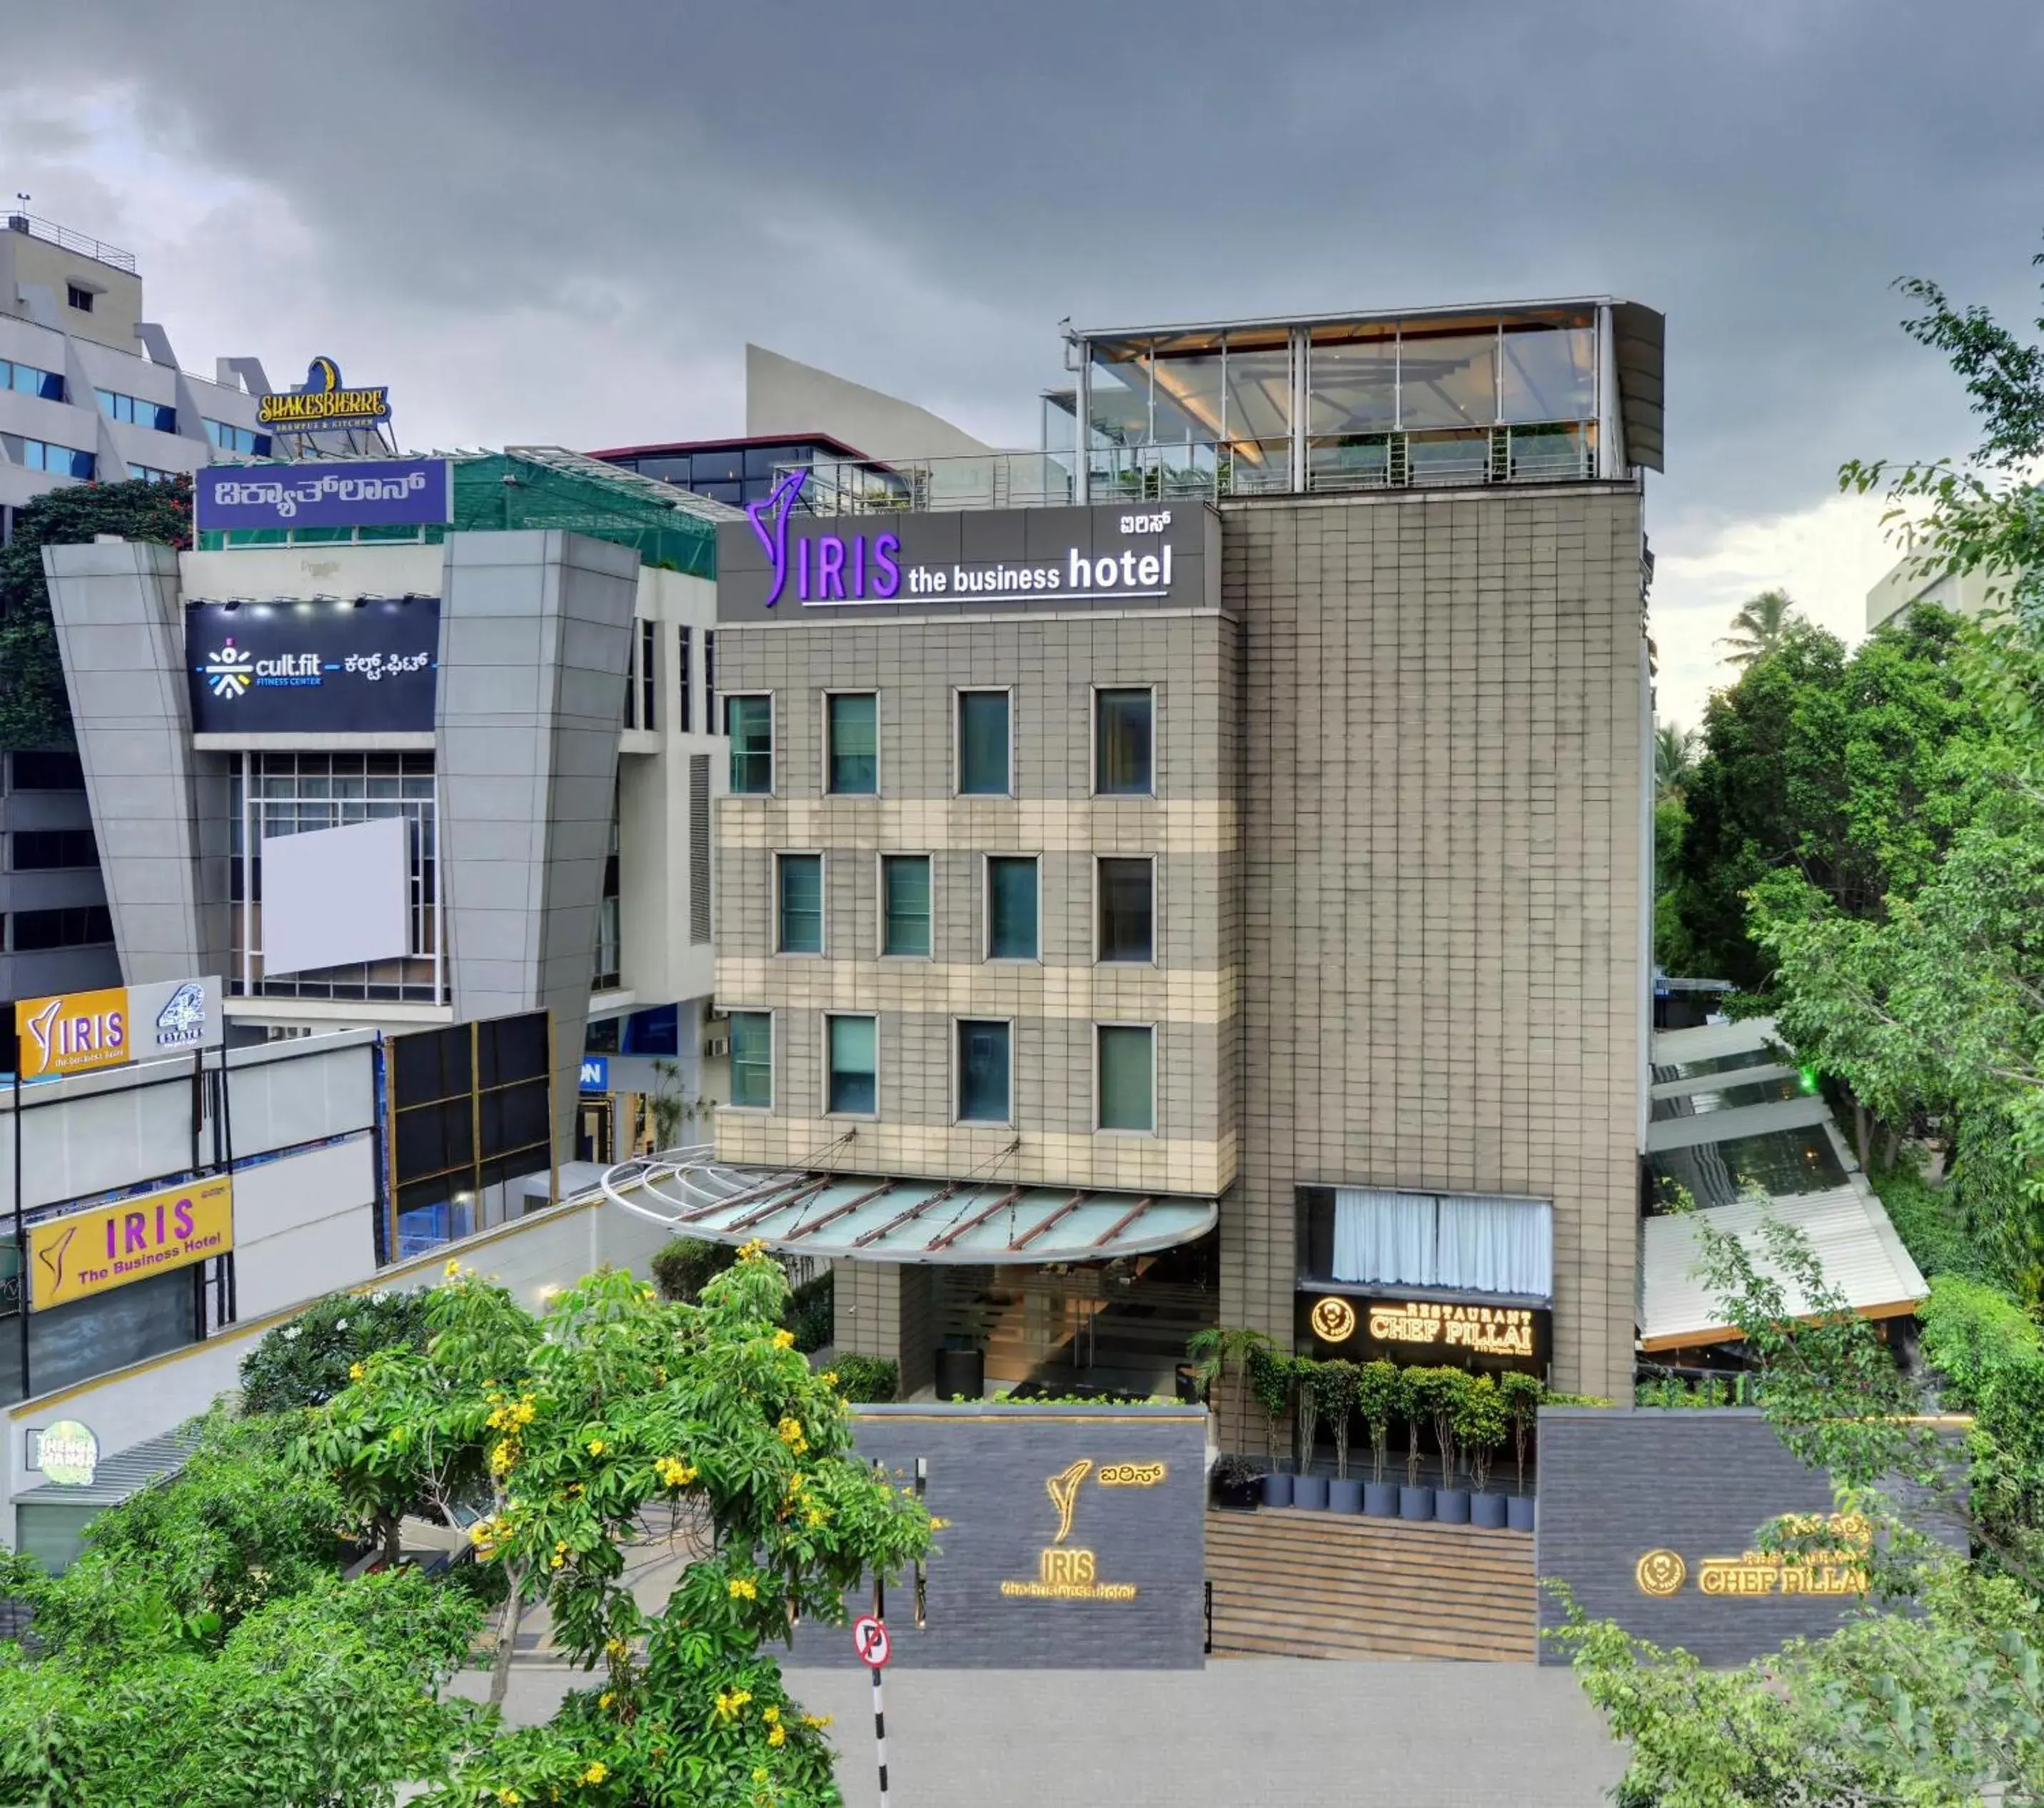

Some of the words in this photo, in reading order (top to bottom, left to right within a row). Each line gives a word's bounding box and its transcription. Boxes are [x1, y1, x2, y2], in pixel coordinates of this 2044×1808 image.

[259, 390, 386, 422] SHAKESBIERRE
[798, 532, 901, 600] IRIS
[909, 566, 947, 592] the
[954, 565, 1060, 592] business
[1069, 545, 1172, 588] hotel
[256, 654, 322, 677] cult.fit
[59, 1011, 124, 1054] IRIS
[107, 1199, 194, 1259] IRIS
[79, 1268, 109, 1285] The
[114, 1247, 180, 1275] Business
[184, 1232, 221, 1253] Hotel
[1407, 1302, 1531, 1326] RESTAURANT
[1369, 1315, 1441, 1343] CHEF
[1445, 1321, 1532, 1350] PILLAI
[1043, 1550, 1094, 1583] IRIS
[1702, 1569, 1776, 1593] CHEF
